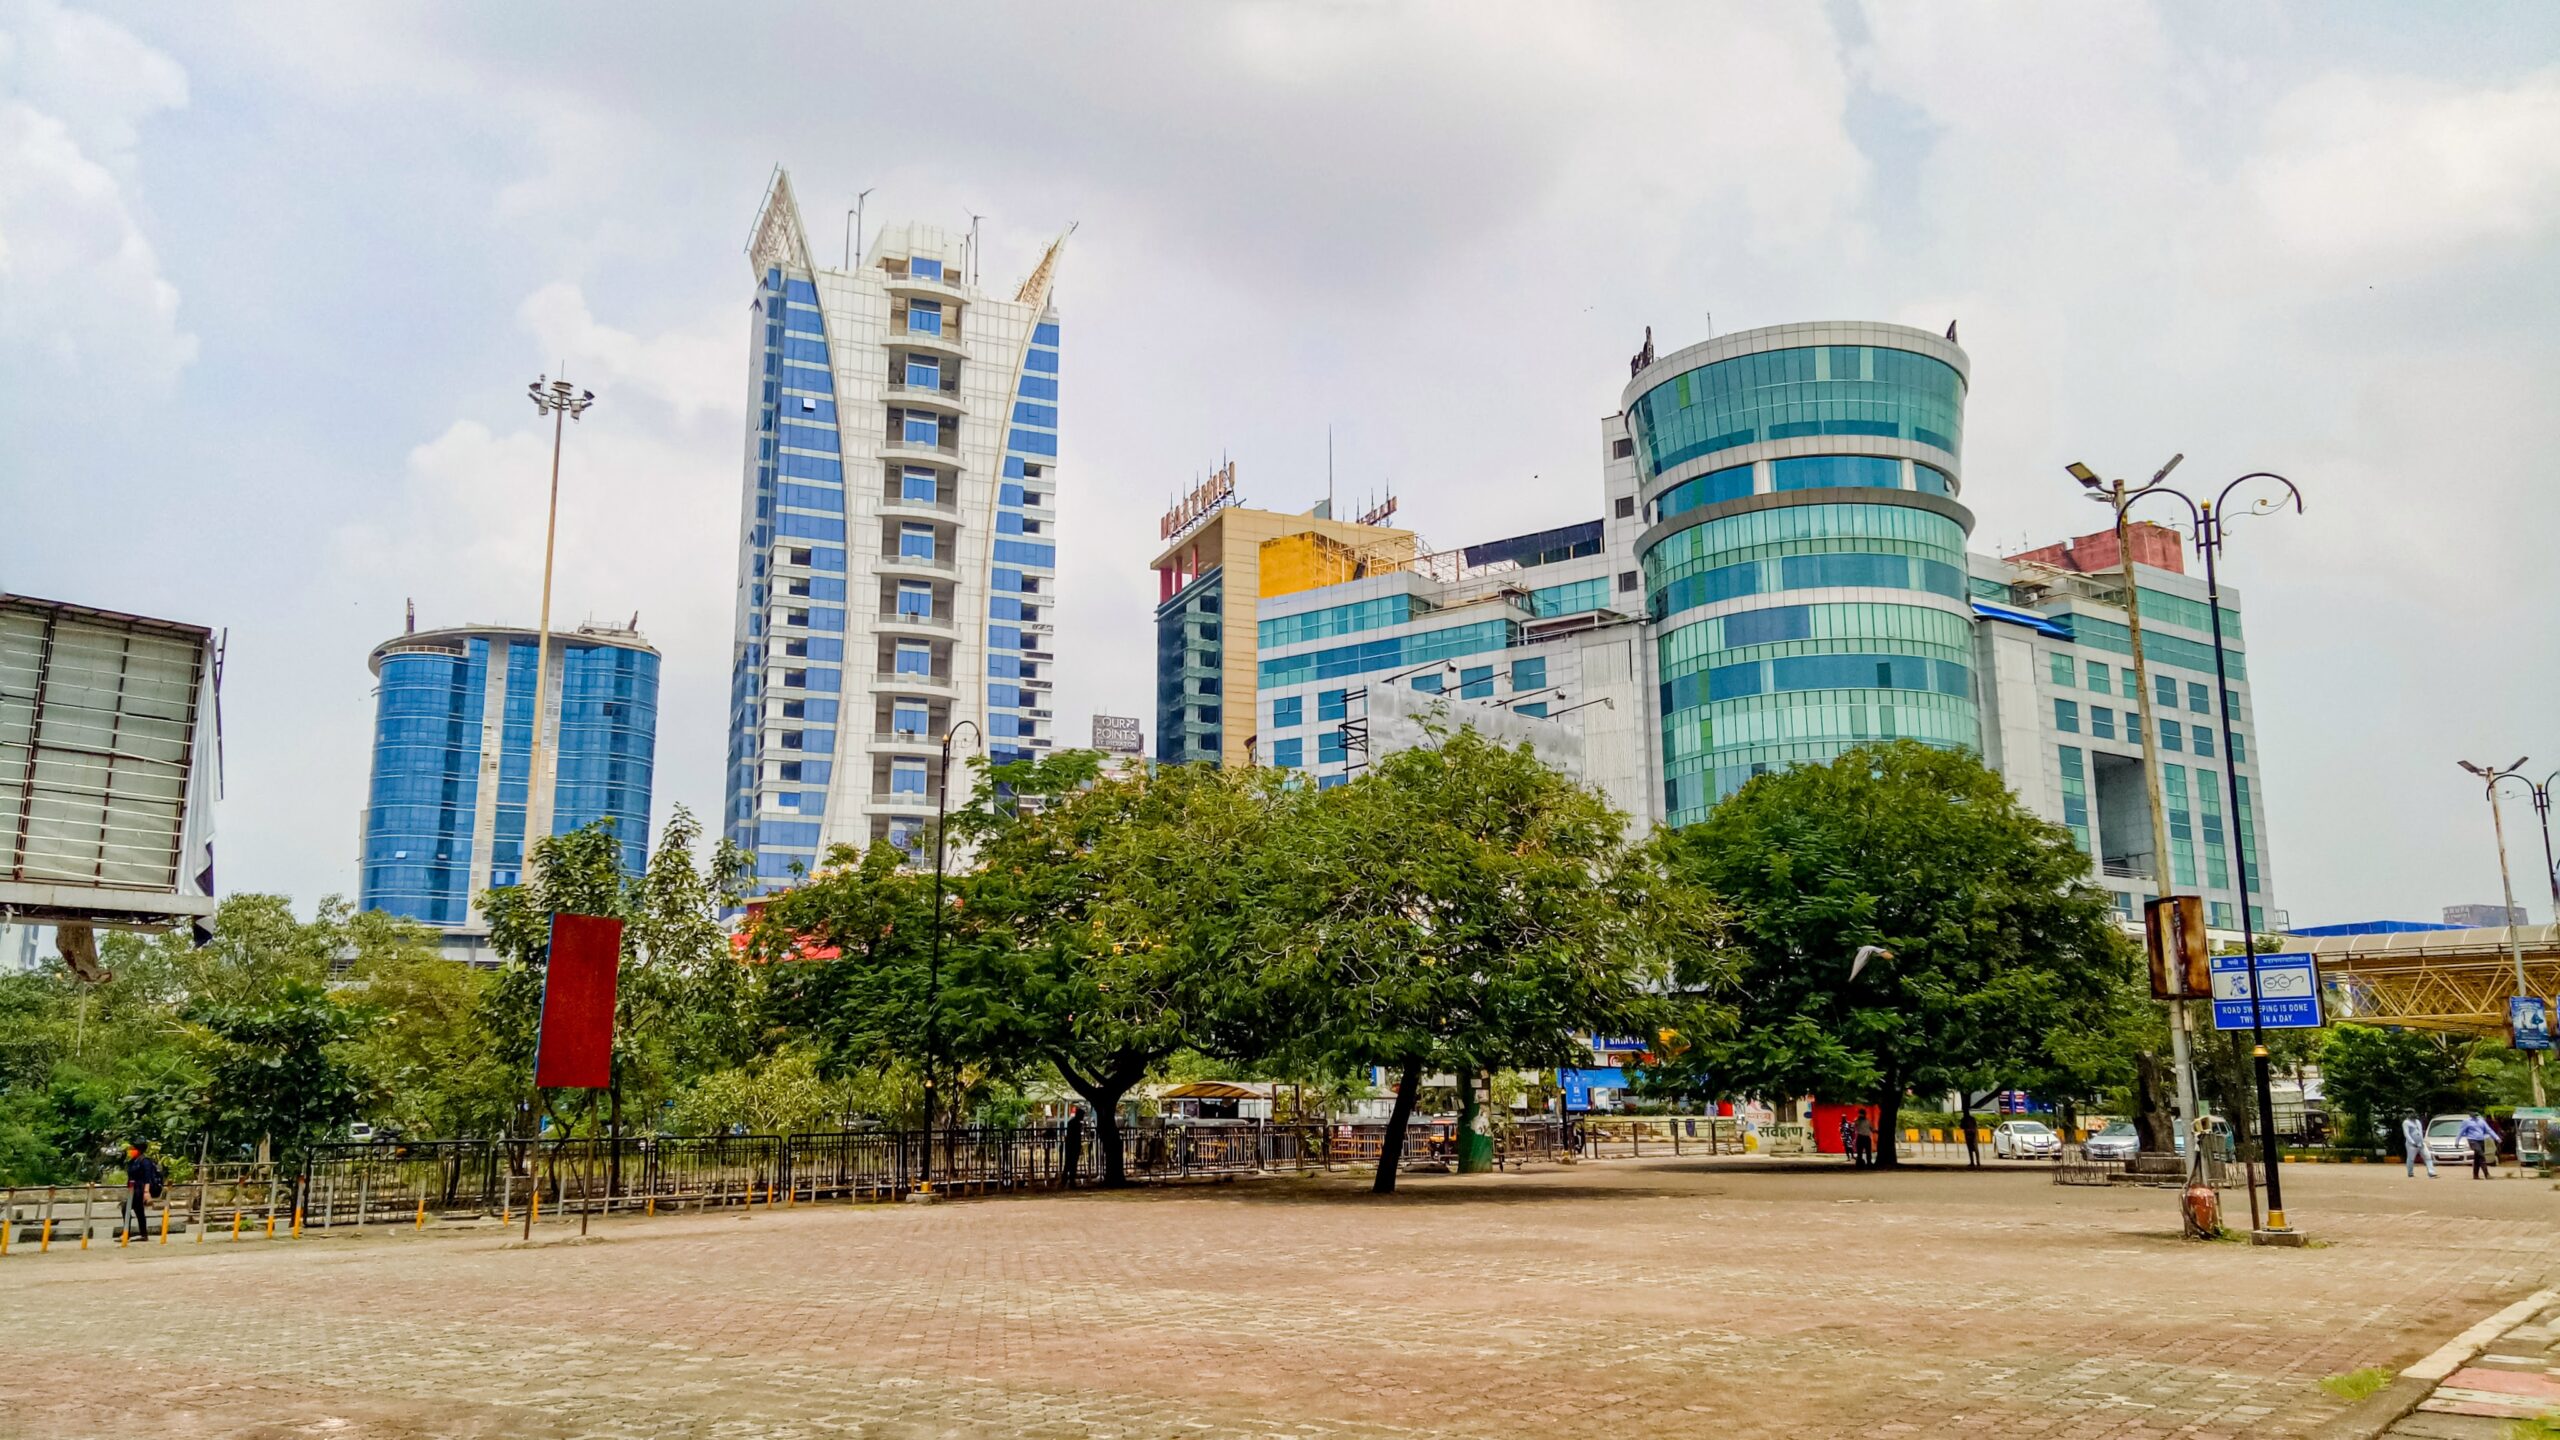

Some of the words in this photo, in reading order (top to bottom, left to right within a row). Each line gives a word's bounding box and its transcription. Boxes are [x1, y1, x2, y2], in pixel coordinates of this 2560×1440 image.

[1096, 728, 1136, 741] POINTS
[2222, 1006, 2241, 1014] ROAD
[2243, 1004, 2278, 1014] SWEPING
[2280, 1004, 2287, 1012] IS
[2288, 1003, 2308, 1012] DONE
[2263, 1015, 2270, 1023] IN
[2272, 1014, 2277, 1023] A
